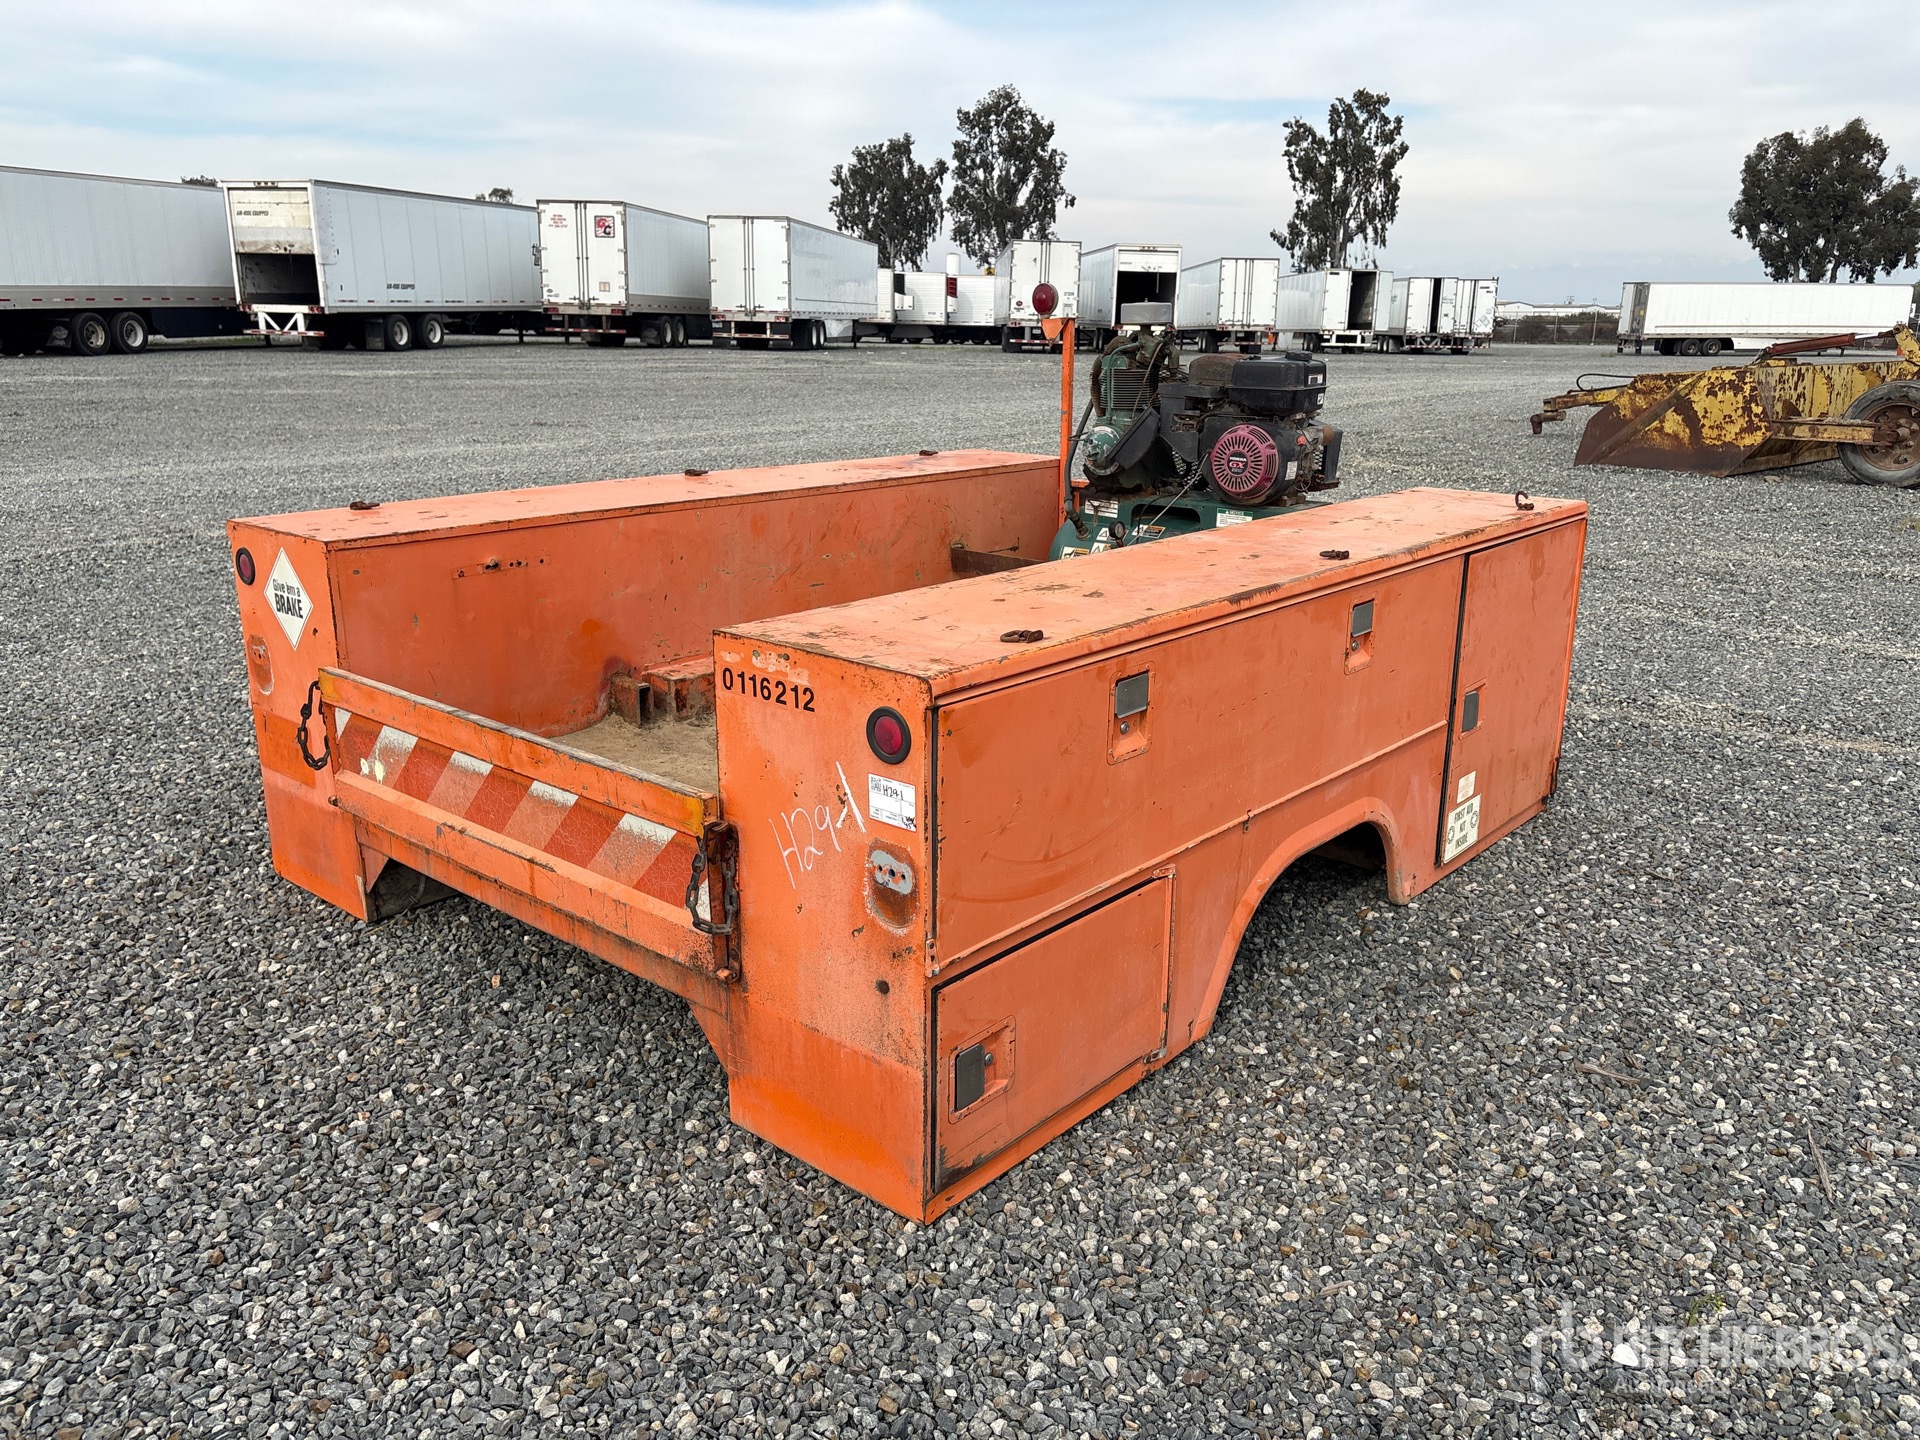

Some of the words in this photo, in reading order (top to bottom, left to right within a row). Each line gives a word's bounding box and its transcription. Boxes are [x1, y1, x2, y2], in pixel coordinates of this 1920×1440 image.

[1229, 461, 1246, 469] GX
[273, 579, 286, 593] Give
[296, 587, 301, 598] a
[275, 593, 303, 619] BRAKE
[722, 667, 816, 712] 0116212
[1454, 807, 1465, 824] FIRST
[1455, 832, 1468, 850] INSIDE
